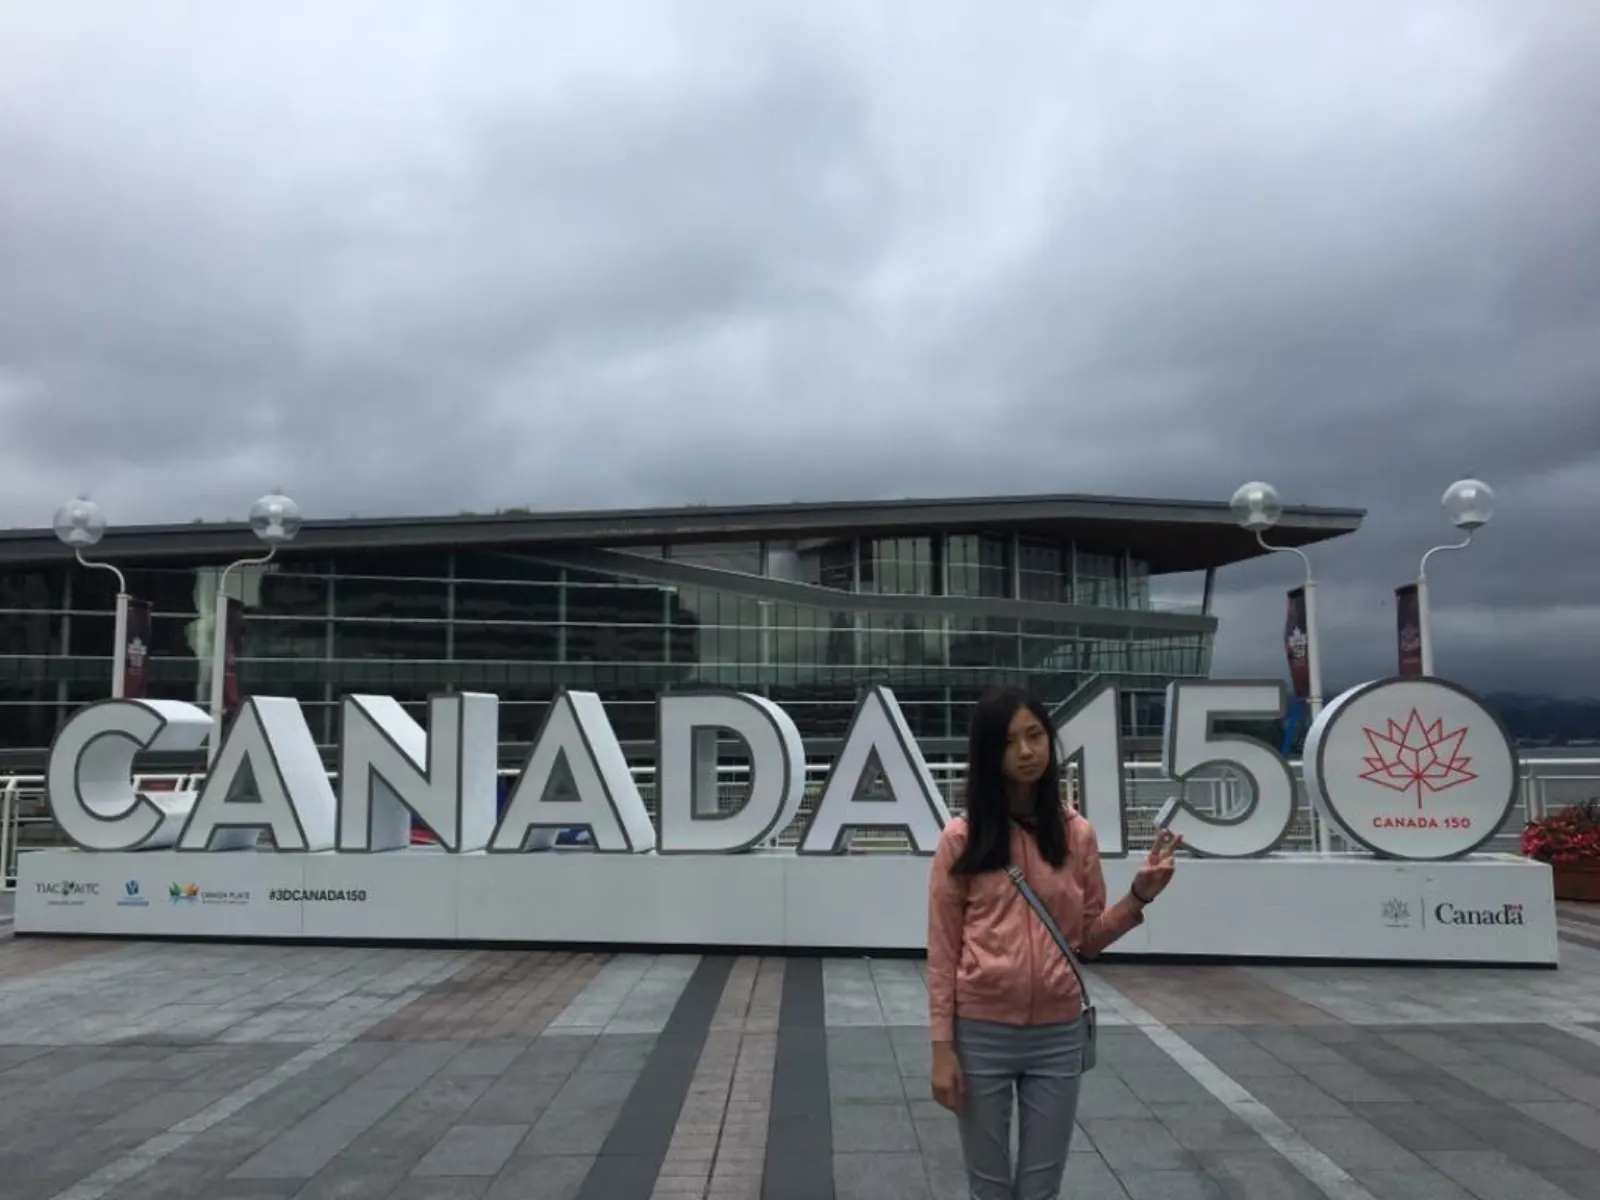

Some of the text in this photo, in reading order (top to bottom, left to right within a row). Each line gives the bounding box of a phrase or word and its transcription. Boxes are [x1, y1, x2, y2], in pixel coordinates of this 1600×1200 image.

[46, 676, 1518, 859] CANADA 150
[1373, 817, 1471, 828] CANADA 150
[269, 887, 367, 901] #3DCANADA150
[1435, 902, 1524, 926] Canada
